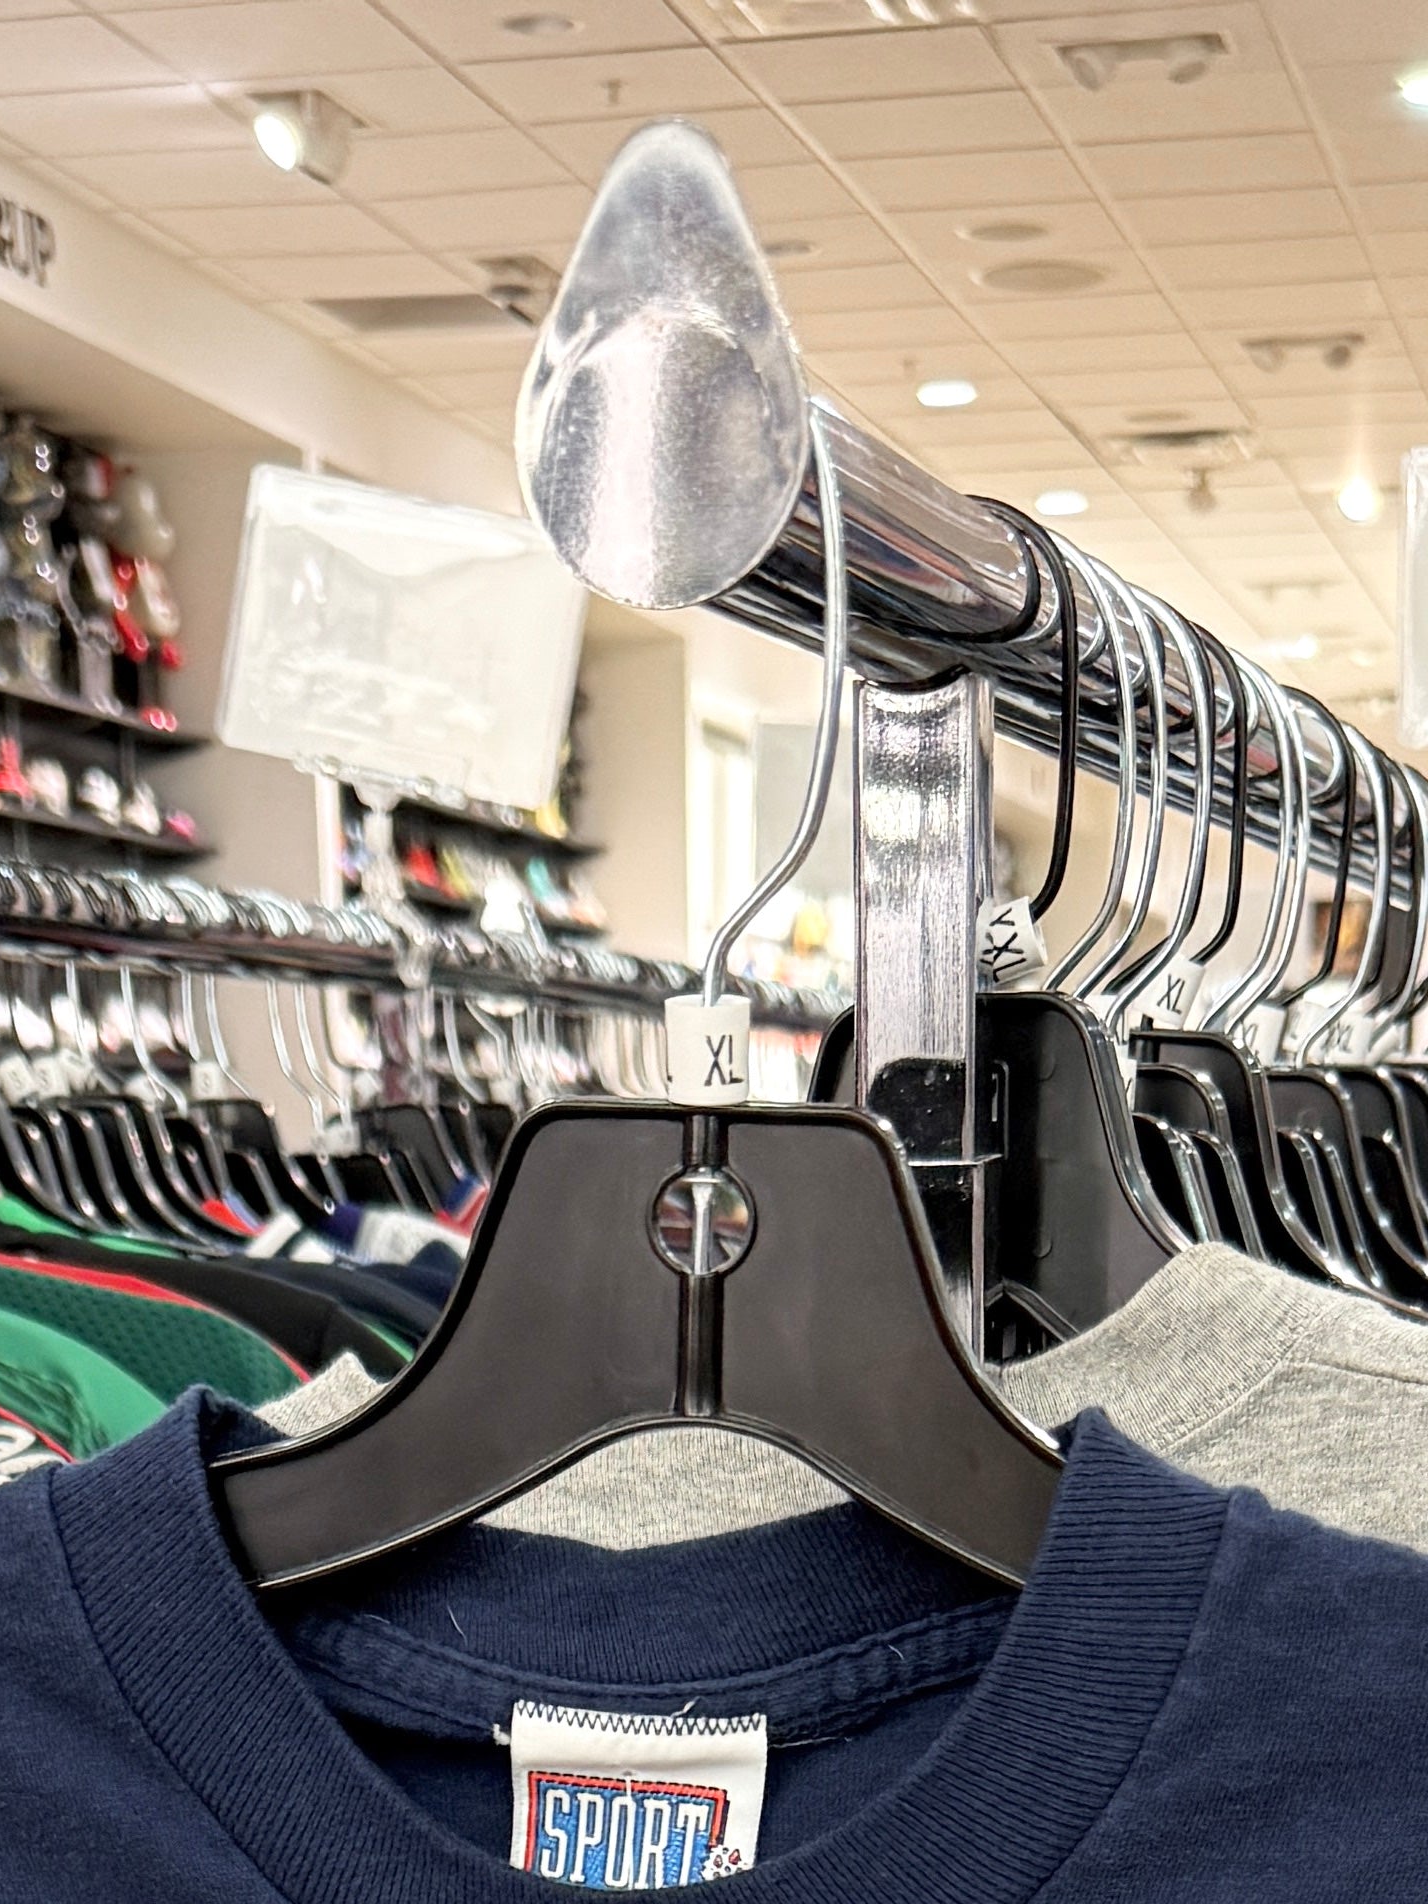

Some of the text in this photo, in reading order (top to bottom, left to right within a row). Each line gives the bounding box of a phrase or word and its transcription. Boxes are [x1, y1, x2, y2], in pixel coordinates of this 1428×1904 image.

[1156, 973, 1197, 1015] XL
[703, 1034, 745, 1087] XL
[539, 1788, 710, 1890] SPORT
